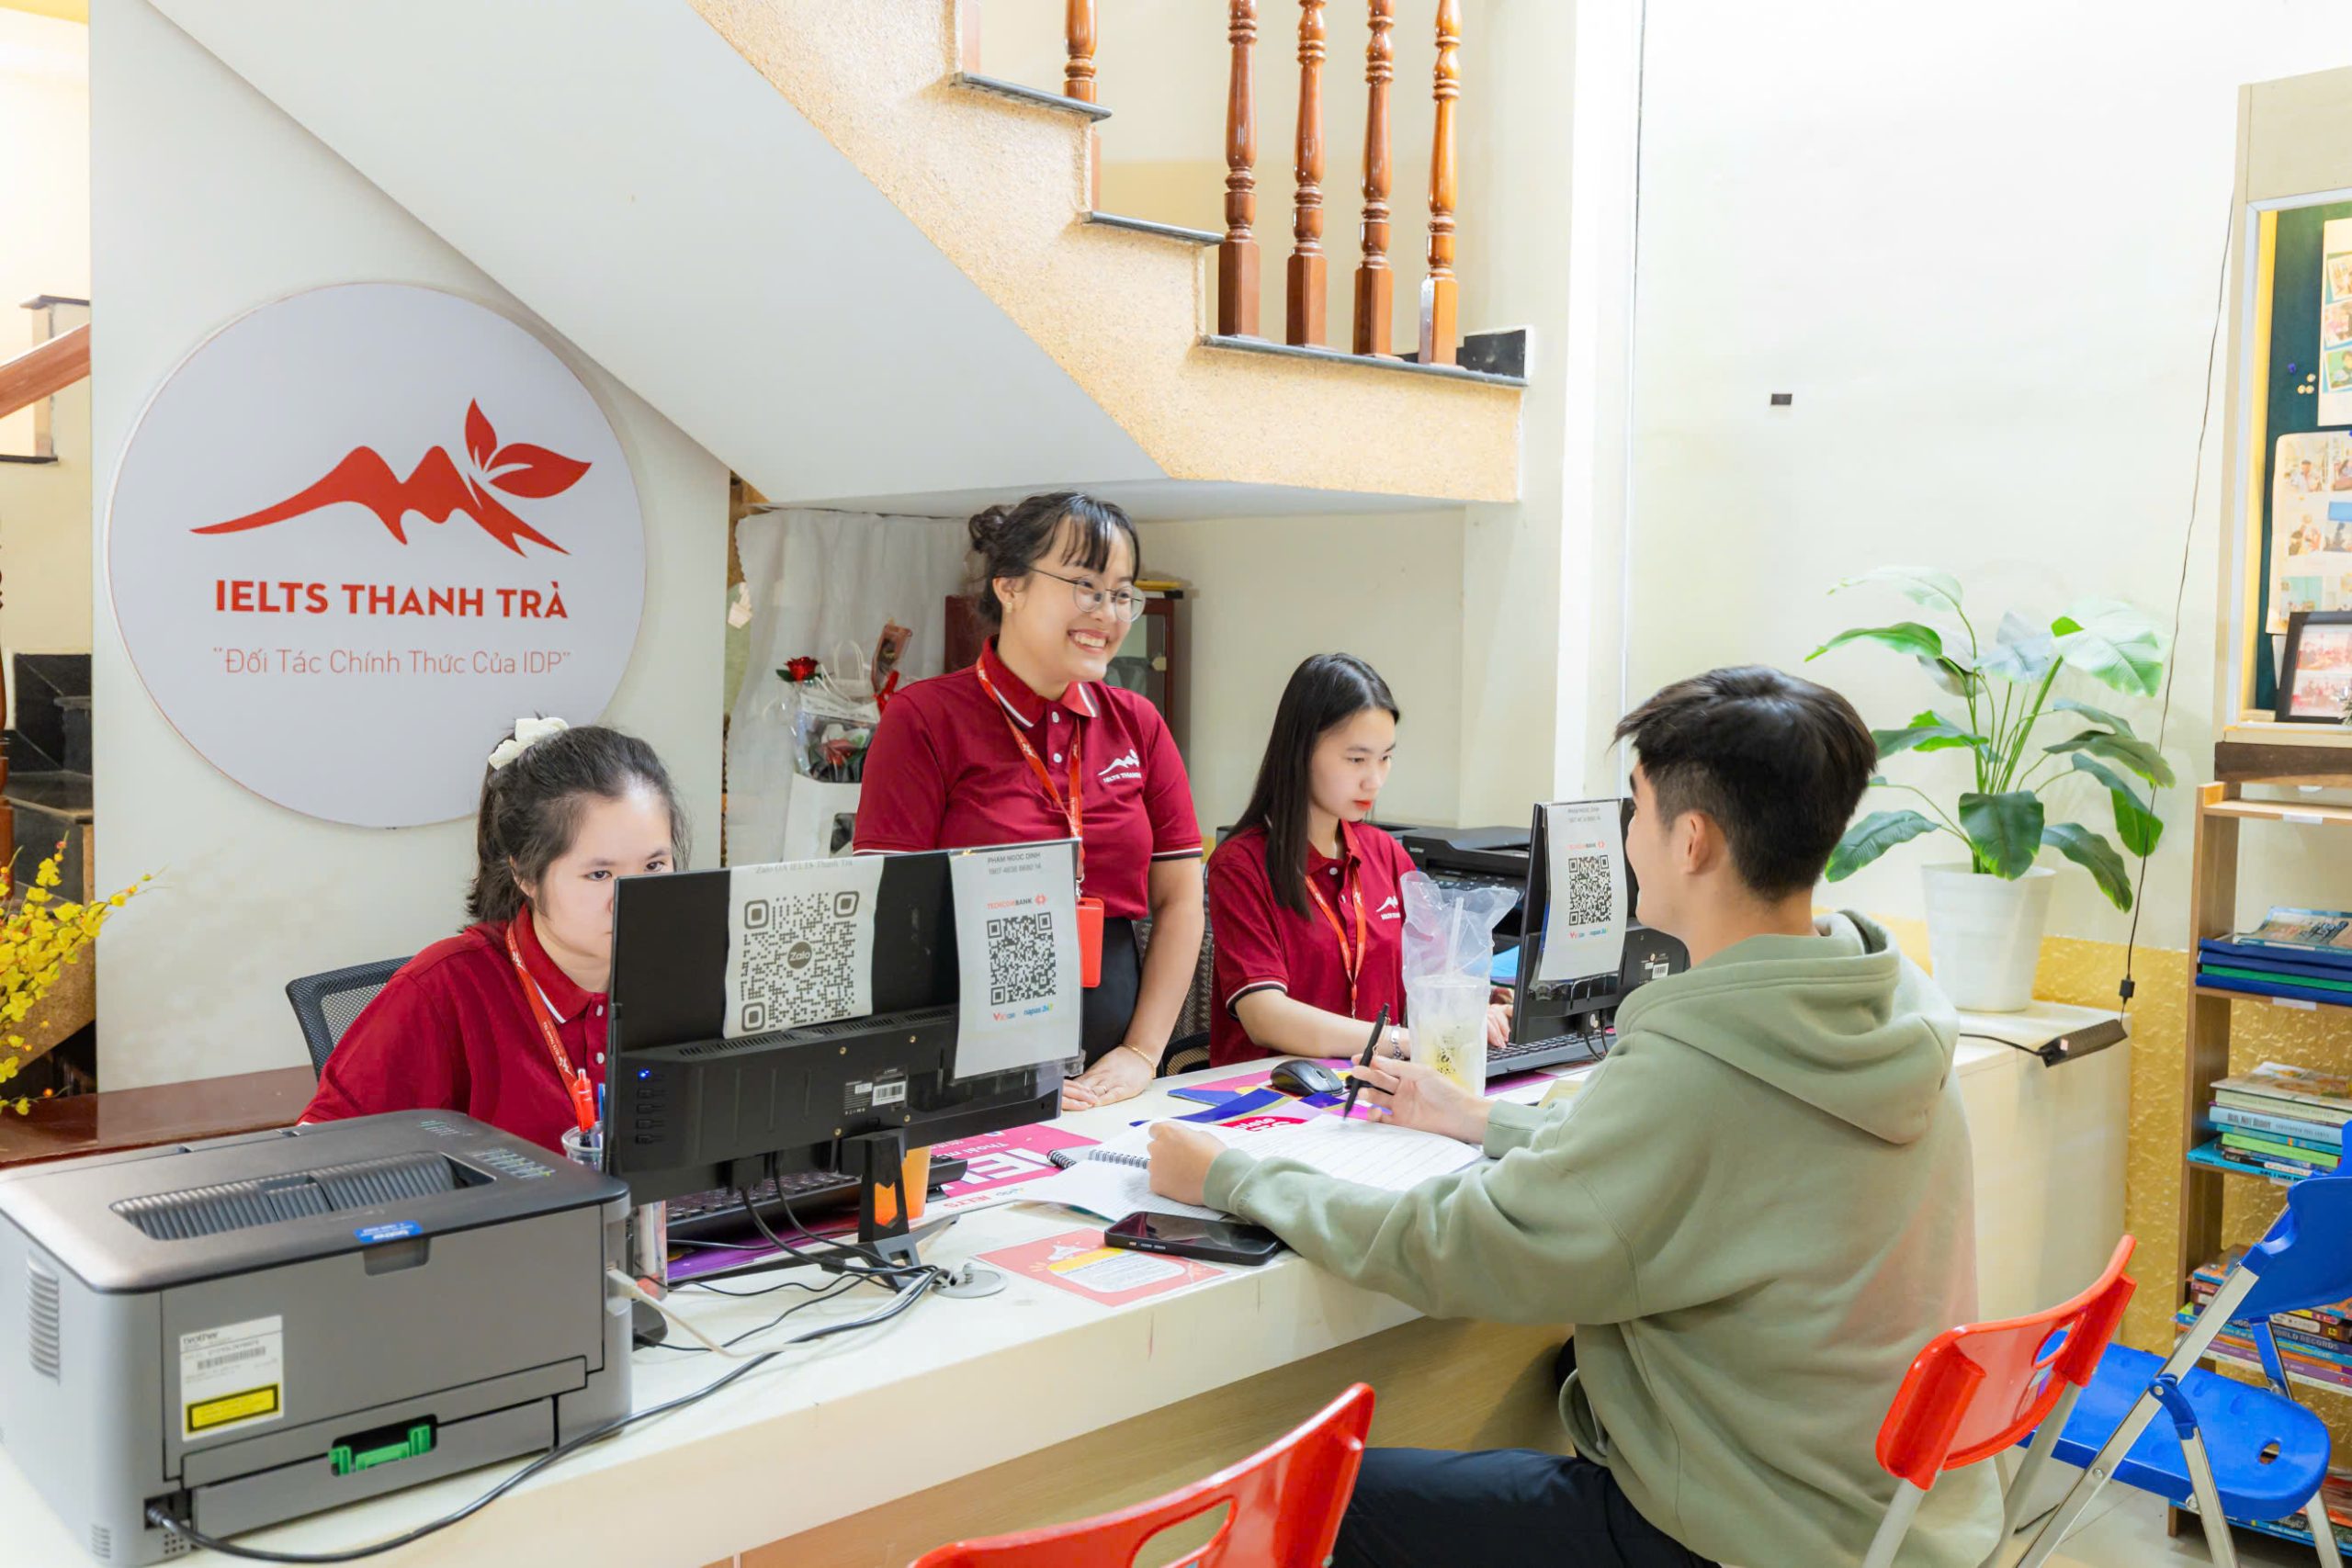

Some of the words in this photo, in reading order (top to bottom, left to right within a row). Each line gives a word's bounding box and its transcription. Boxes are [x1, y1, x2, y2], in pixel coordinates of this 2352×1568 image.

[216, 580, 328, 614] IELTS
[341, 584, 483, 616] THANH
[496, 581, 569, 618] TRÀ
[276, 649, 322, 674] Tác
[330, 649, 400, 675] Chính
[408, 649, 465, 675] Thức
[472, 650, 515, 675] Của
[789, 950, 811, 962] Zalo
